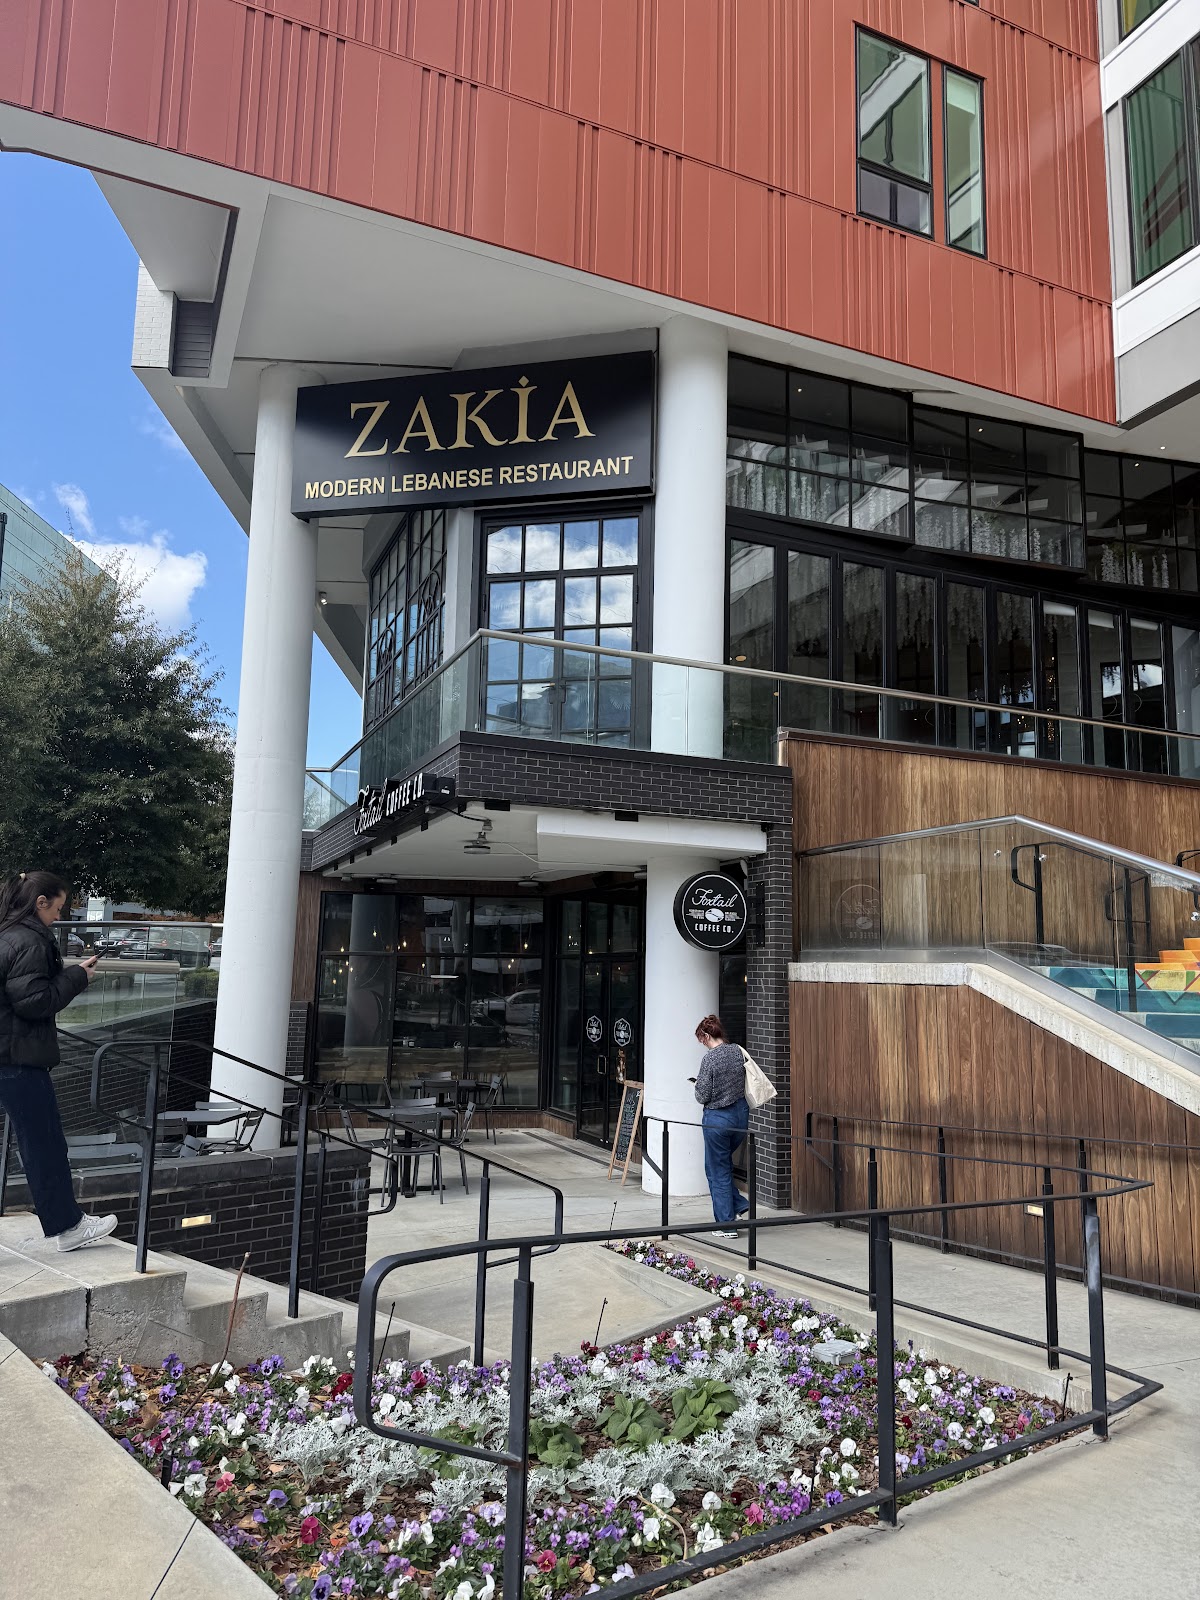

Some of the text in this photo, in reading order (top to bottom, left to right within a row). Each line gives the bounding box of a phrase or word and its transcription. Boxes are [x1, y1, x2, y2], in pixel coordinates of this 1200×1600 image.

[304, 456, 634, 499] MODERN LEBANESE RESTAURANT
[386, 780, 411, 817] COFFEE
[412, 772, 425, 801] CO.
[692, 889, 738, 907] Foxtail
[695, 923, 734, 933] COFFEE CO.
[83, 1227, 97, 1238] N
